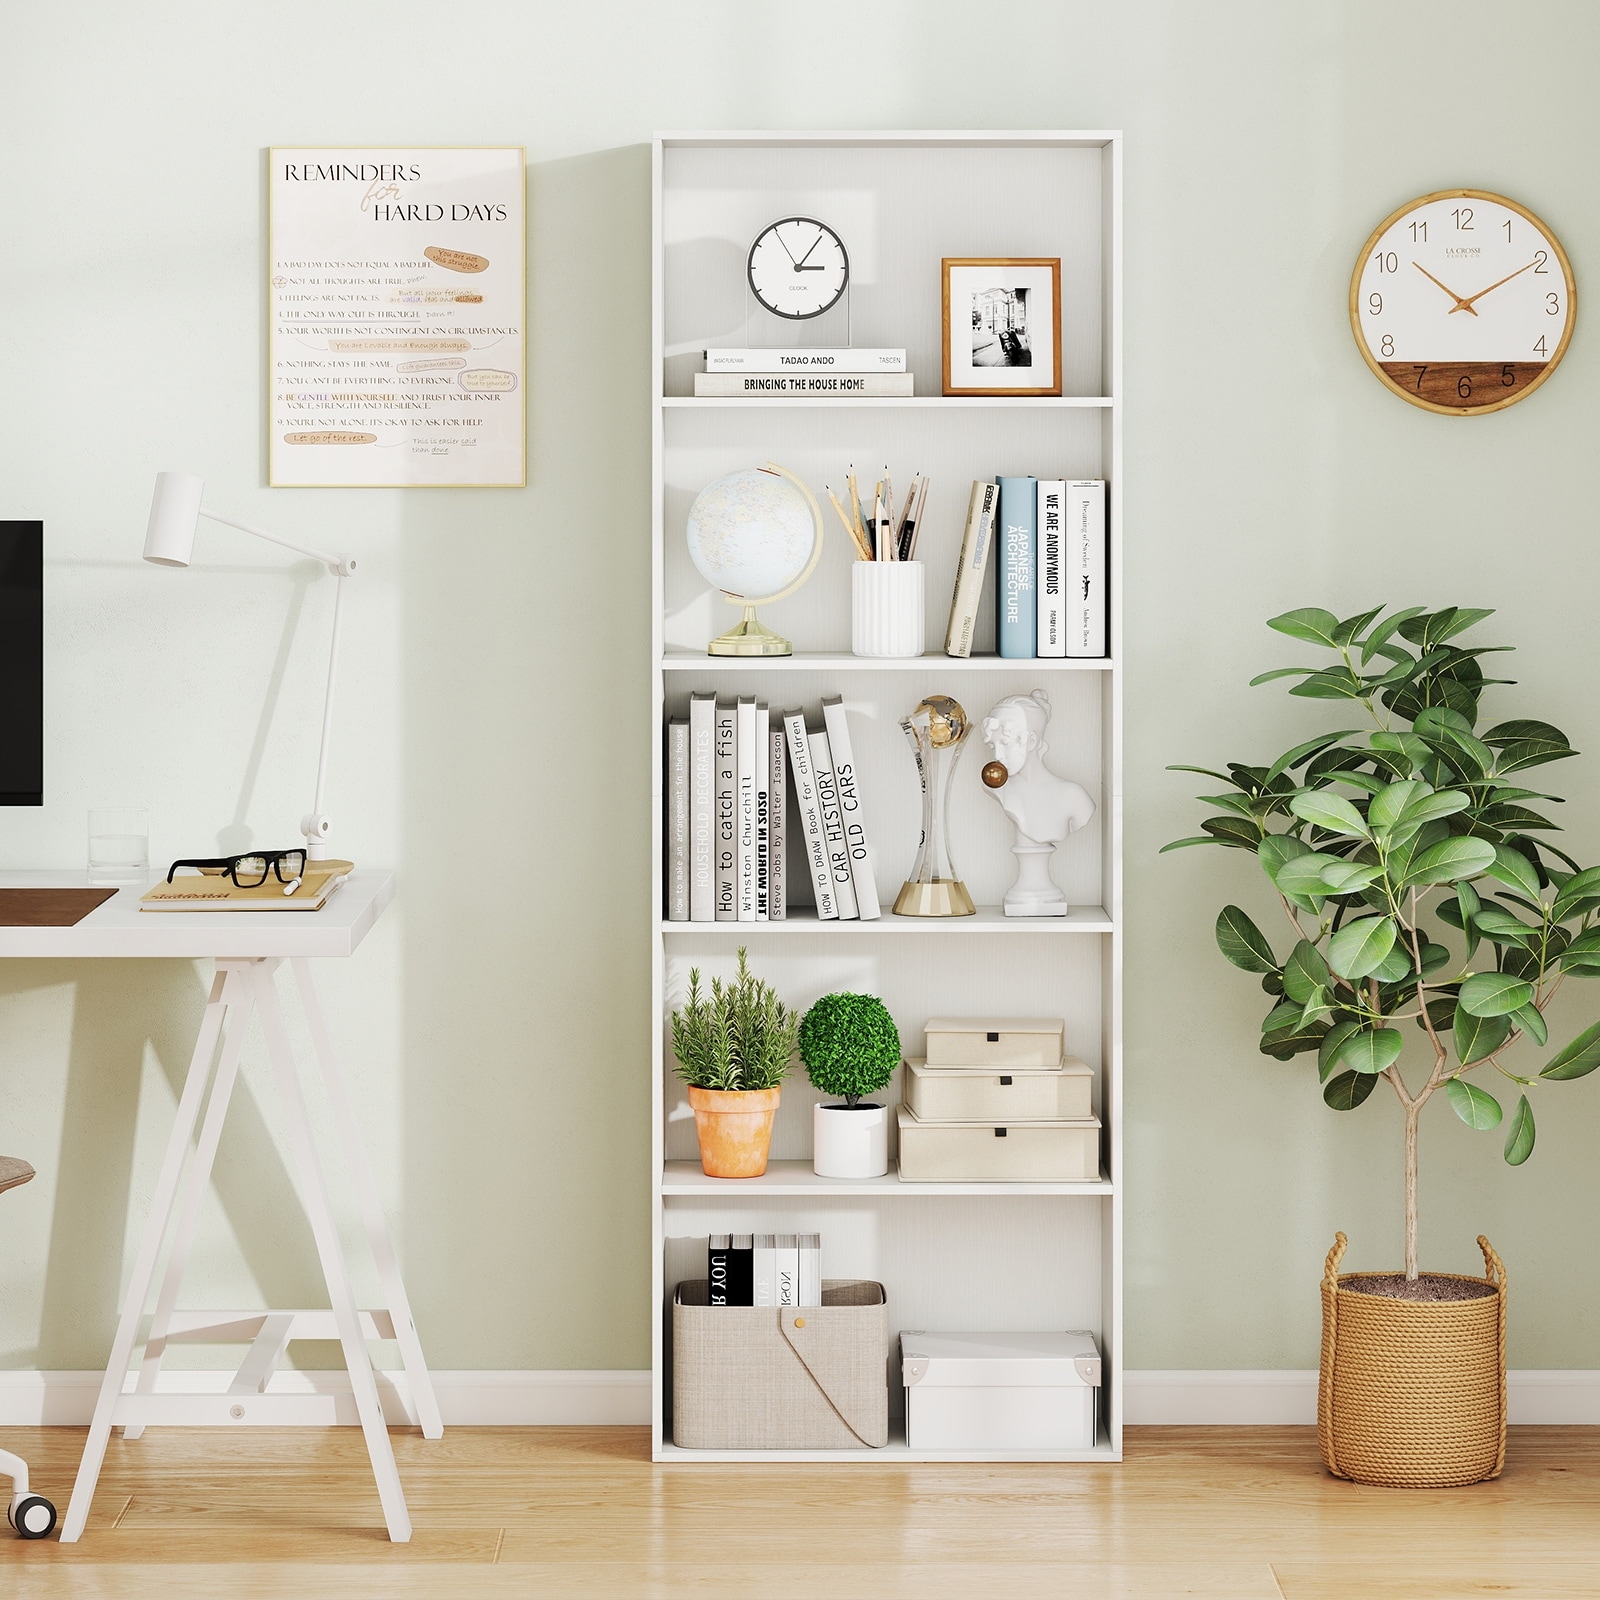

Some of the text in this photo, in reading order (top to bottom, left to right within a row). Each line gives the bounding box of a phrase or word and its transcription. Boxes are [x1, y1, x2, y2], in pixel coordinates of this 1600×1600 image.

[285, 164, 421, 181] REMINDERS
[360, 179, 402, 212] for
[374, 204, 508, 221] HARD DAYS
[1451, 208, 1474, 230] 12
[1408, 221, 1427, 242] 11
[1502, 220, 1512, 243] 1
[1374, 252, 1398, 274] 10
[1534, 250, 1548, 274] 2
[1369, 292, 1382, 316] 9
[1546, 292, 1559, 316] 3
[1380, 334, 1394, 357] 8
[1532, 335, 1548, 357] 4
[780, 356, 834, 365] TADAO ANDO
[744, 379, 865, 390] BRINGING THE HOUSE HOME
[1413, 366, 1427, 388] 7
[1458, 376, 1472, 398] 6
[1501, 365, 1515, 387] 5
[1080, 500, 1090, 533] Dreaming
[1047, 494, 1058, 595] WE ARE ANONYMOUS
[1018, 526, 1028, 591] JAPANESE
[1008, 525, 1018, 624] ARCHITECTURE
[696, 730, 708, 888] HOUSEHOLD DECORATES
[718, 719, 732, 912] How to catch a fish
[793, 721, 832, 914] HOW TO DRAW Book for children
[837, 764, 866, 860] OLD CARS
[773, 734, 782, 916] Steve Jobs by Walter Isaacson
[817, 770, 850, 883] CAR HISTORY
[742, 776, 752, 911] Winston Churchill
[675, 884, 682, 894] to
